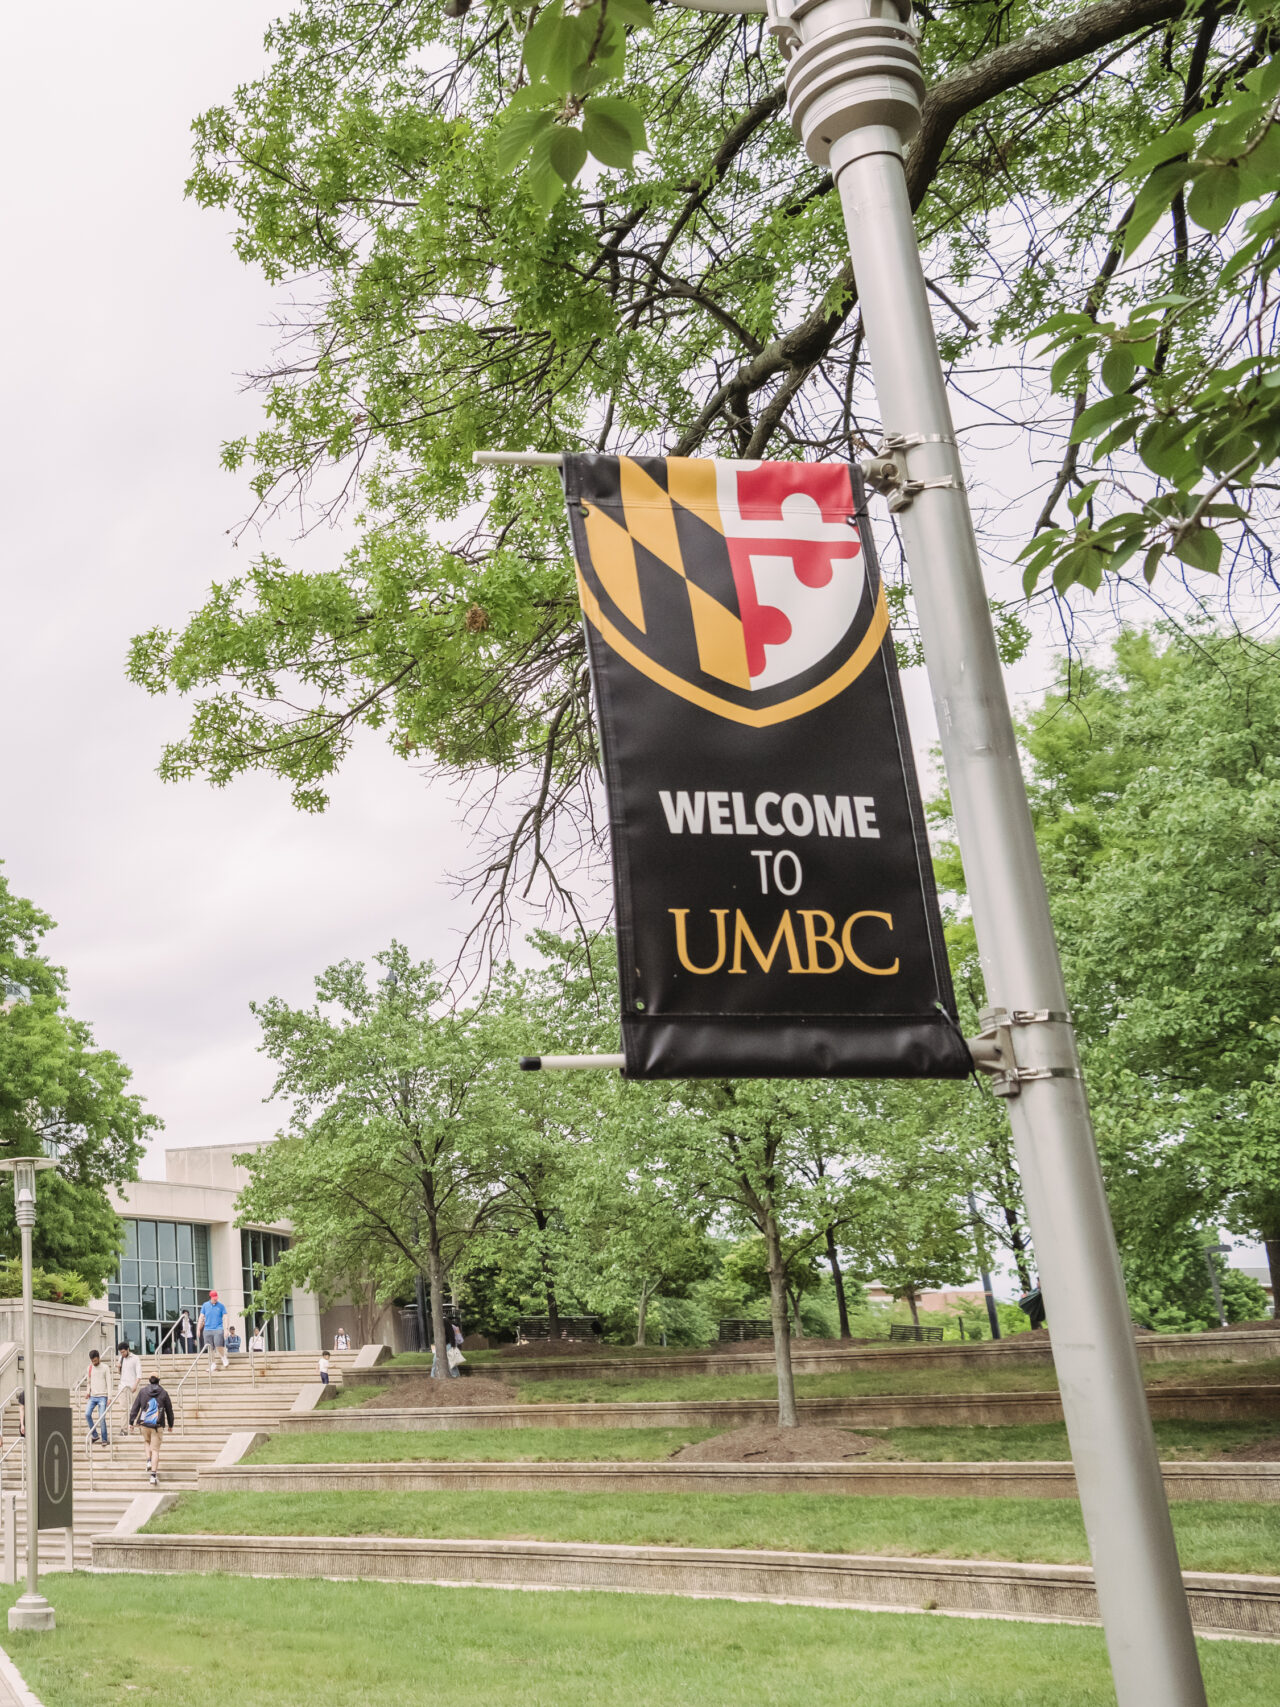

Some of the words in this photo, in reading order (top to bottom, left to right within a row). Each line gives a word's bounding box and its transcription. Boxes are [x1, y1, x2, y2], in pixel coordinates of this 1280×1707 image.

[658, 790, 881, 839] WELCOME
[750, 849, 803, 896] TO
[667, 908, 900, 976] UMBC
